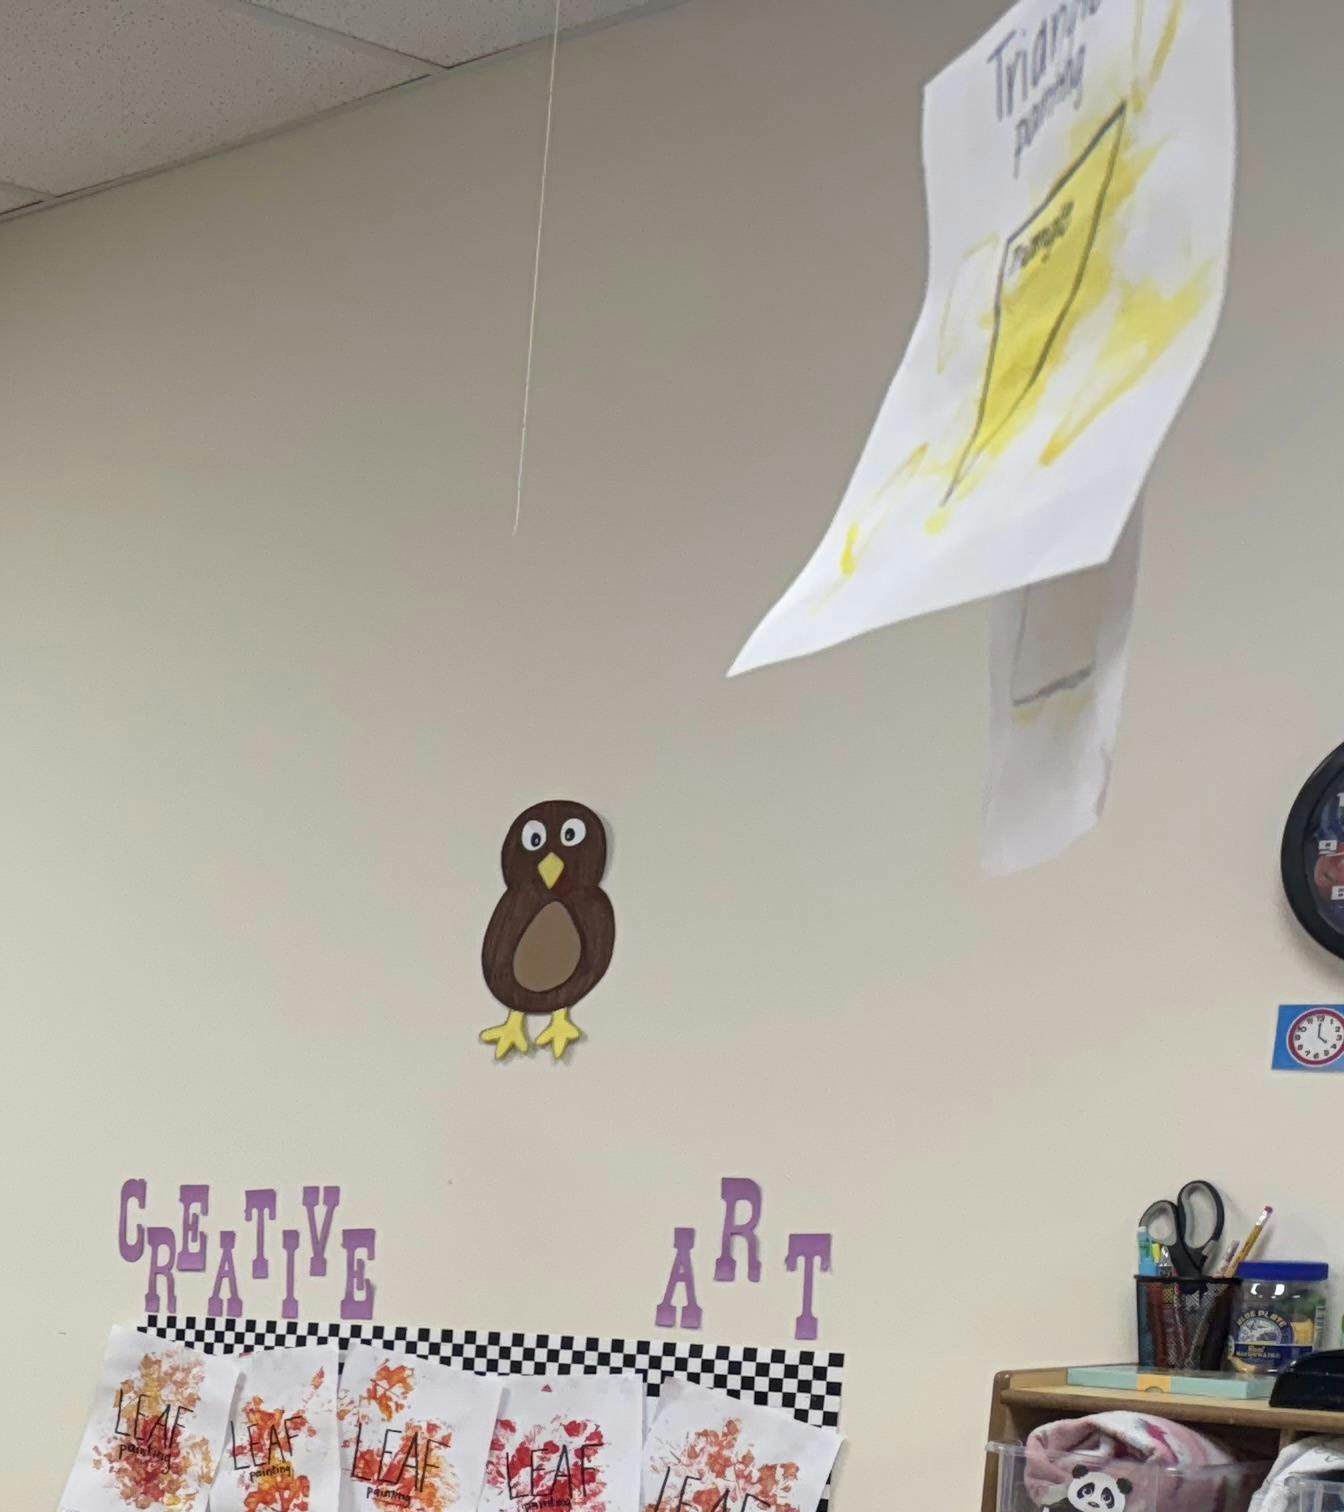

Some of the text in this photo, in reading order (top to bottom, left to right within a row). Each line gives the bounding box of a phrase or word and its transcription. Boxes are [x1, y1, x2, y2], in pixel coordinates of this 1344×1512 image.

[118, 1177, 832, 1340] CREATIVE ART
[115, 1389, 194, 1448] LEAF
[230, 1415, 303, 1471] LEAF
[249, 1463, 291, 1482] painting
[350, 1423, 450, 1493] LEAF
[506, 1443, 603, 1500] LEAF
